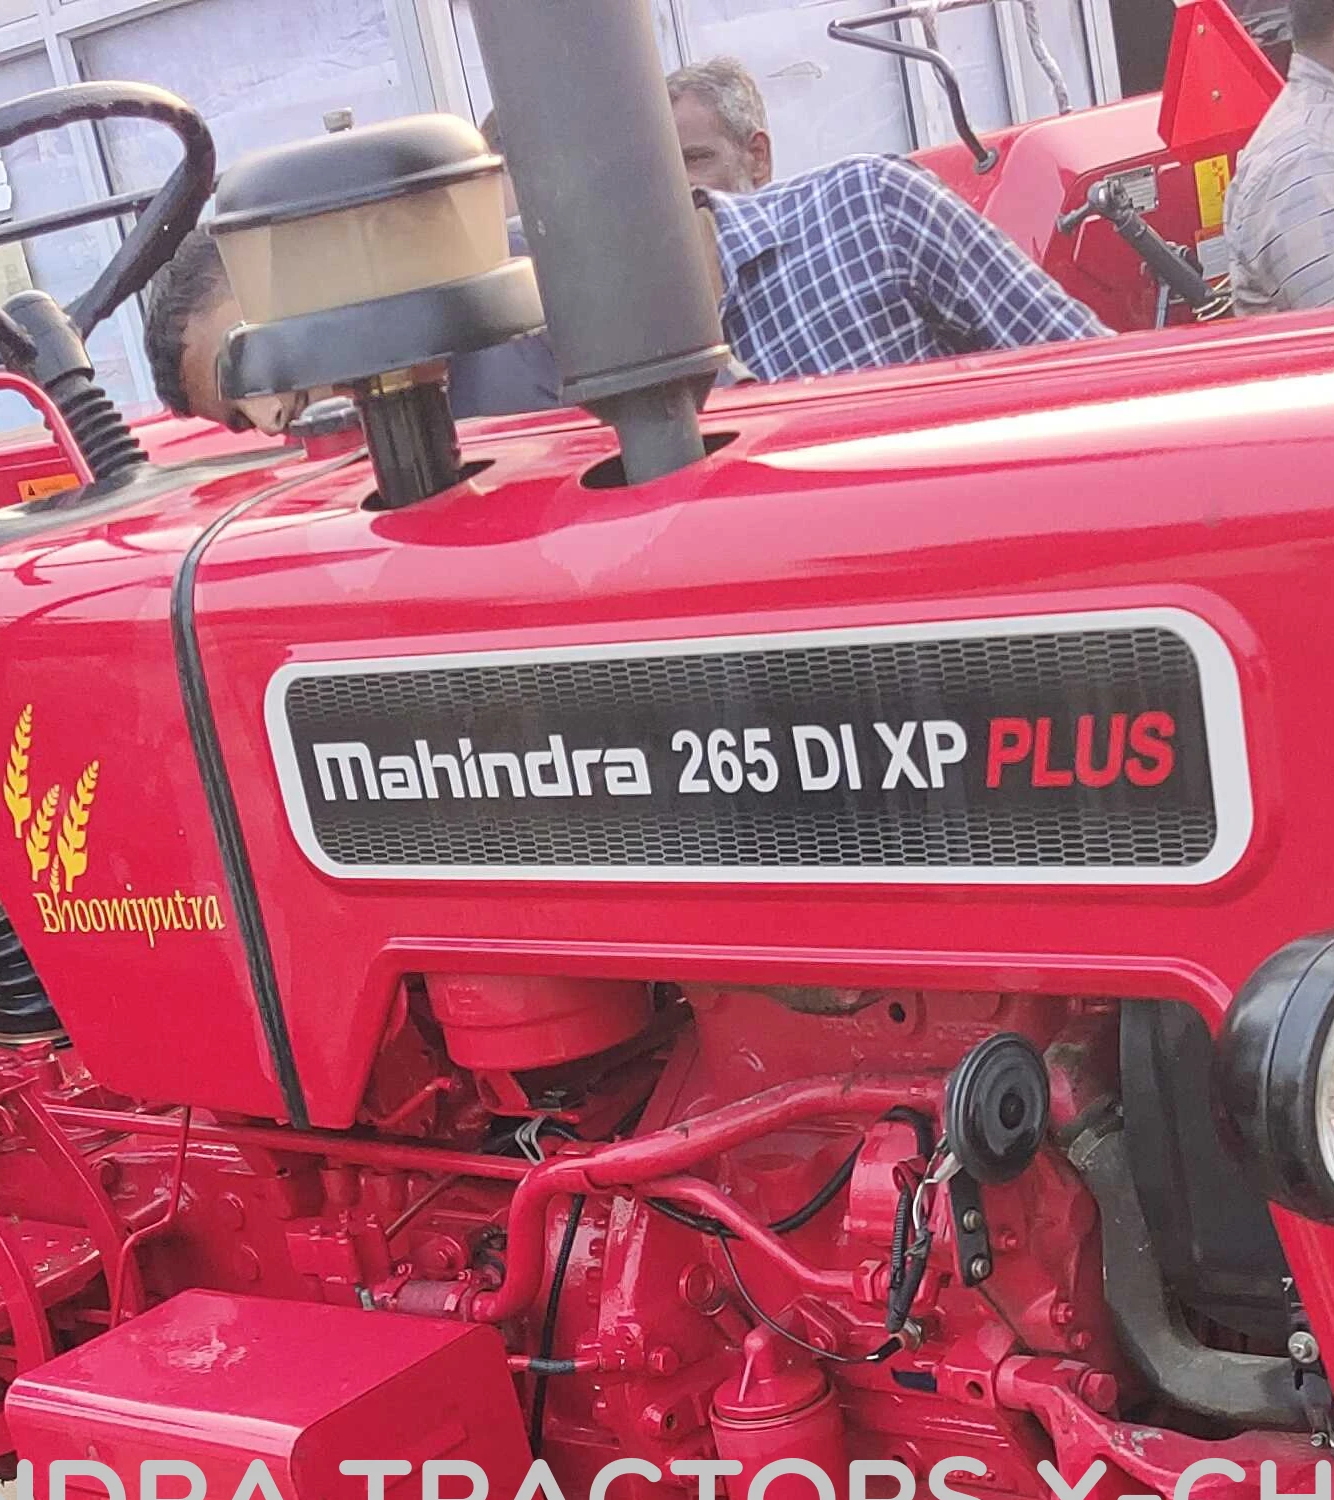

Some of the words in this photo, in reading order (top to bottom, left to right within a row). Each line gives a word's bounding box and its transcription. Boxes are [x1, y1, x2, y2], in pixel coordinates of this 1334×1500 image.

[312, 732, 651, 800] Mahindra
[671, 727, 777, 796] 265
[795, 724, 862, 793] DI
[881, 719, 970, 791] XP
[985, 711, 1176, 789] PLUS
[33, 884, 225, 948] Bhoomiputra
